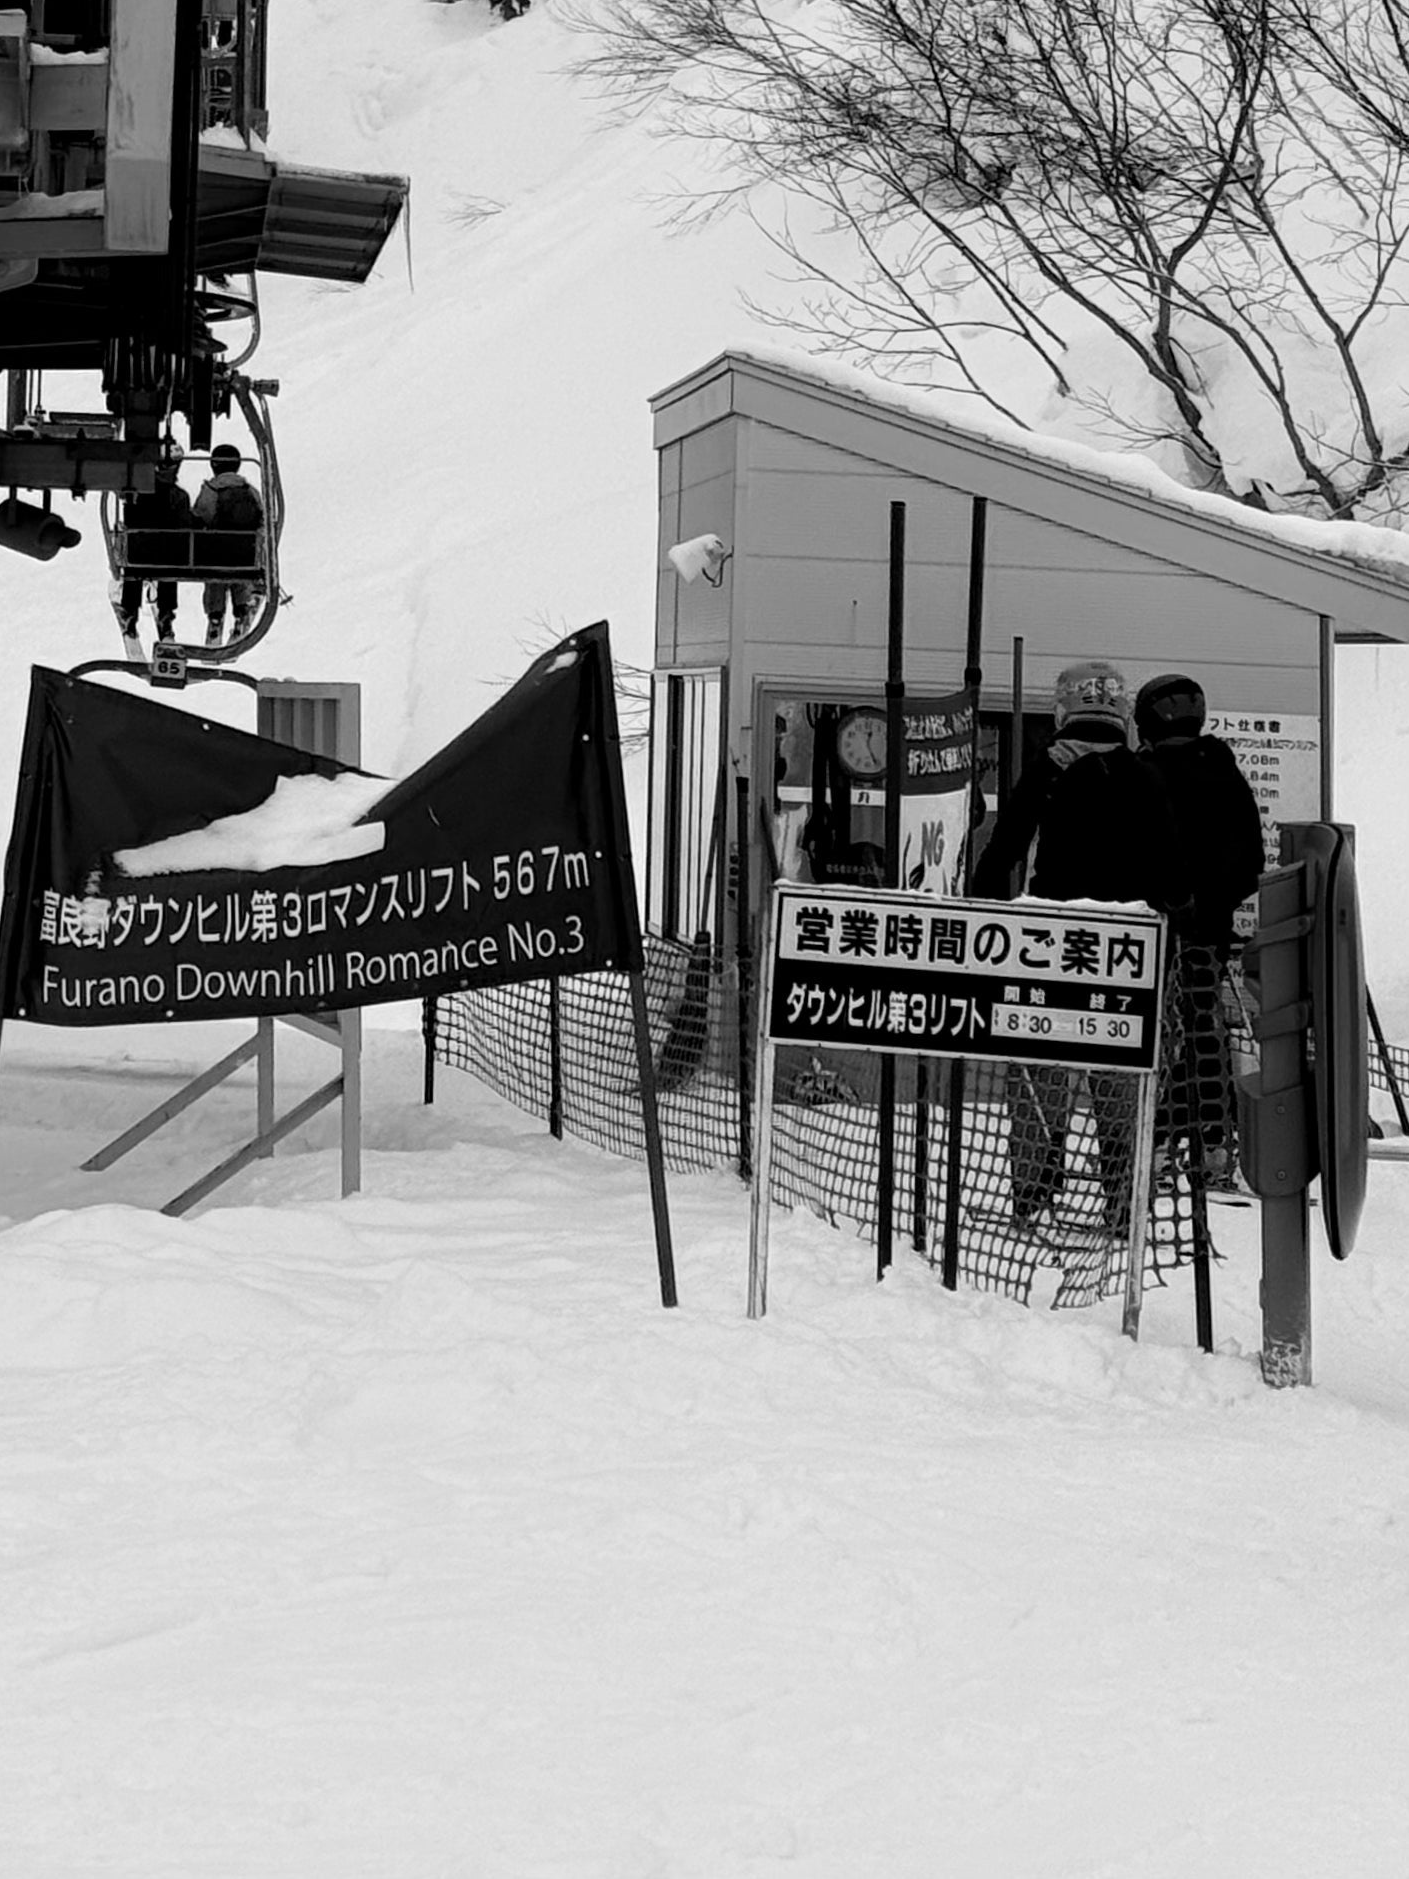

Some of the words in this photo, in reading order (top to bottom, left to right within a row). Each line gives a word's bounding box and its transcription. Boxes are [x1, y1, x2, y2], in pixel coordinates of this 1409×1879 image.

[921, 820, 945, 867] NG
[493, 846, 590, 900] 567m
[43, 965, 165, 1007] Furano
[177, 953, 334, 1001] Downhill
[347, 936, 498, 989] Romance
[508, 915, 585, 961] No.3
[795, 906, 1147, 979] 営業時間のご案内
[786, 982, 986, 1039] ダウンヒル第3リフト
